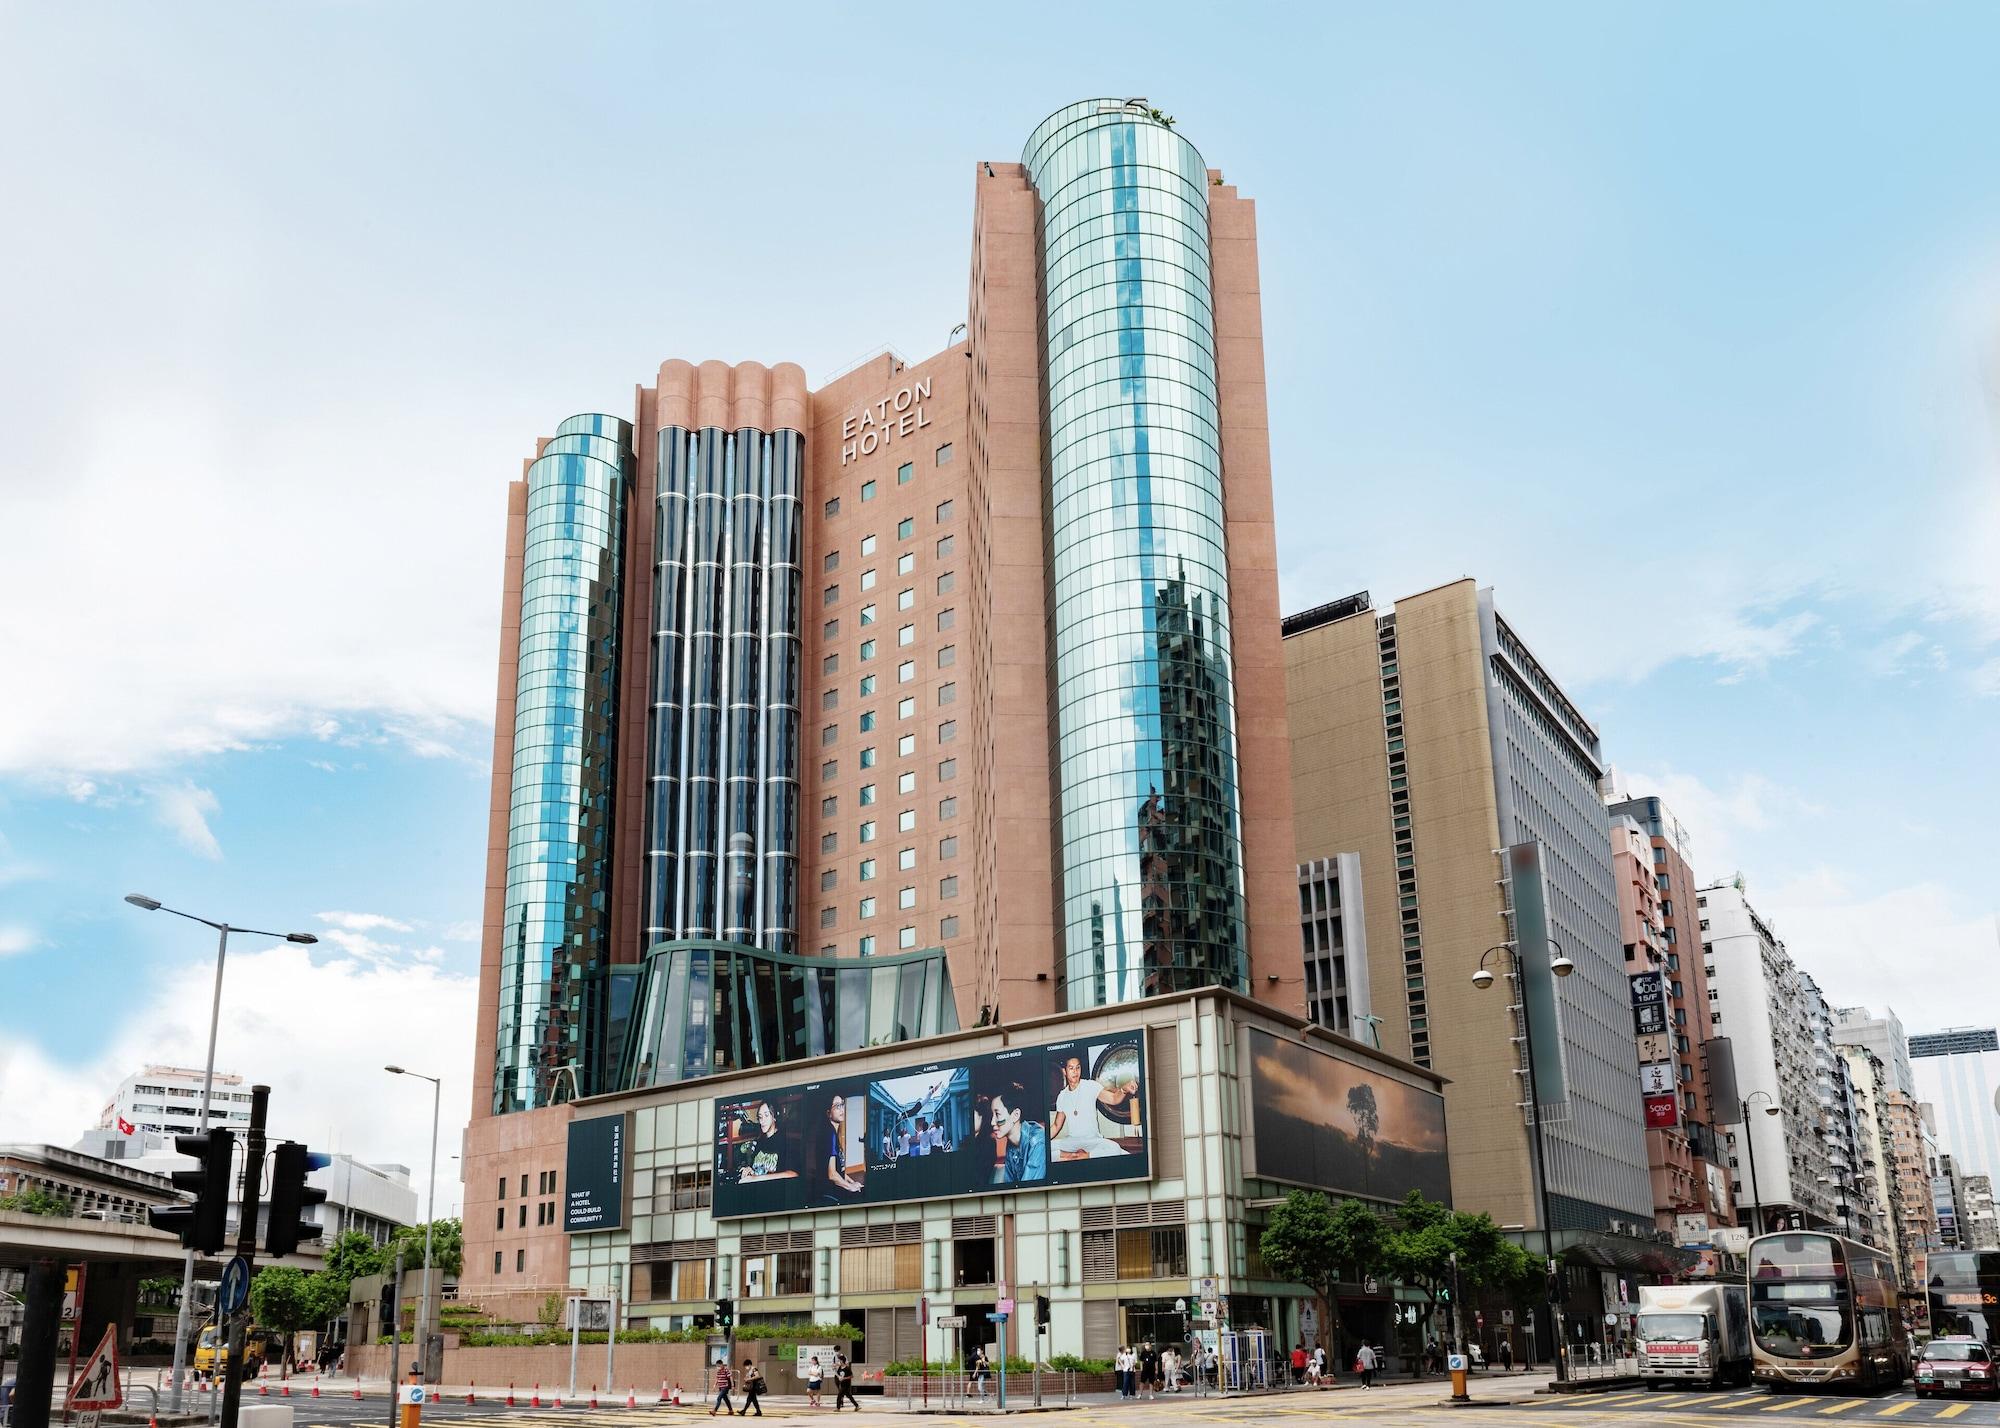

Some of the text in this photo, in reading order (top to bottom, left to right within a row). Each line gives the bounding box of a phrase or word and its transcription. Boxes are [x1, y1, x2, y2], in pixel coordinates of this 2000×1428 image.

[843, 376, 931, 441] EATON
[842, 406, 931, 467] HOTEL
[1638, 993, 1657, 1002] 15/F
[571, 1191, 585, 1199] WHAT
[587, 1206, 601, 1214] BUILD
[570, 1215, 599, 1223] COMMUNITY
[1731, 1232, 1745, 1241] 128
[82, 1414, 95, 1424] End
